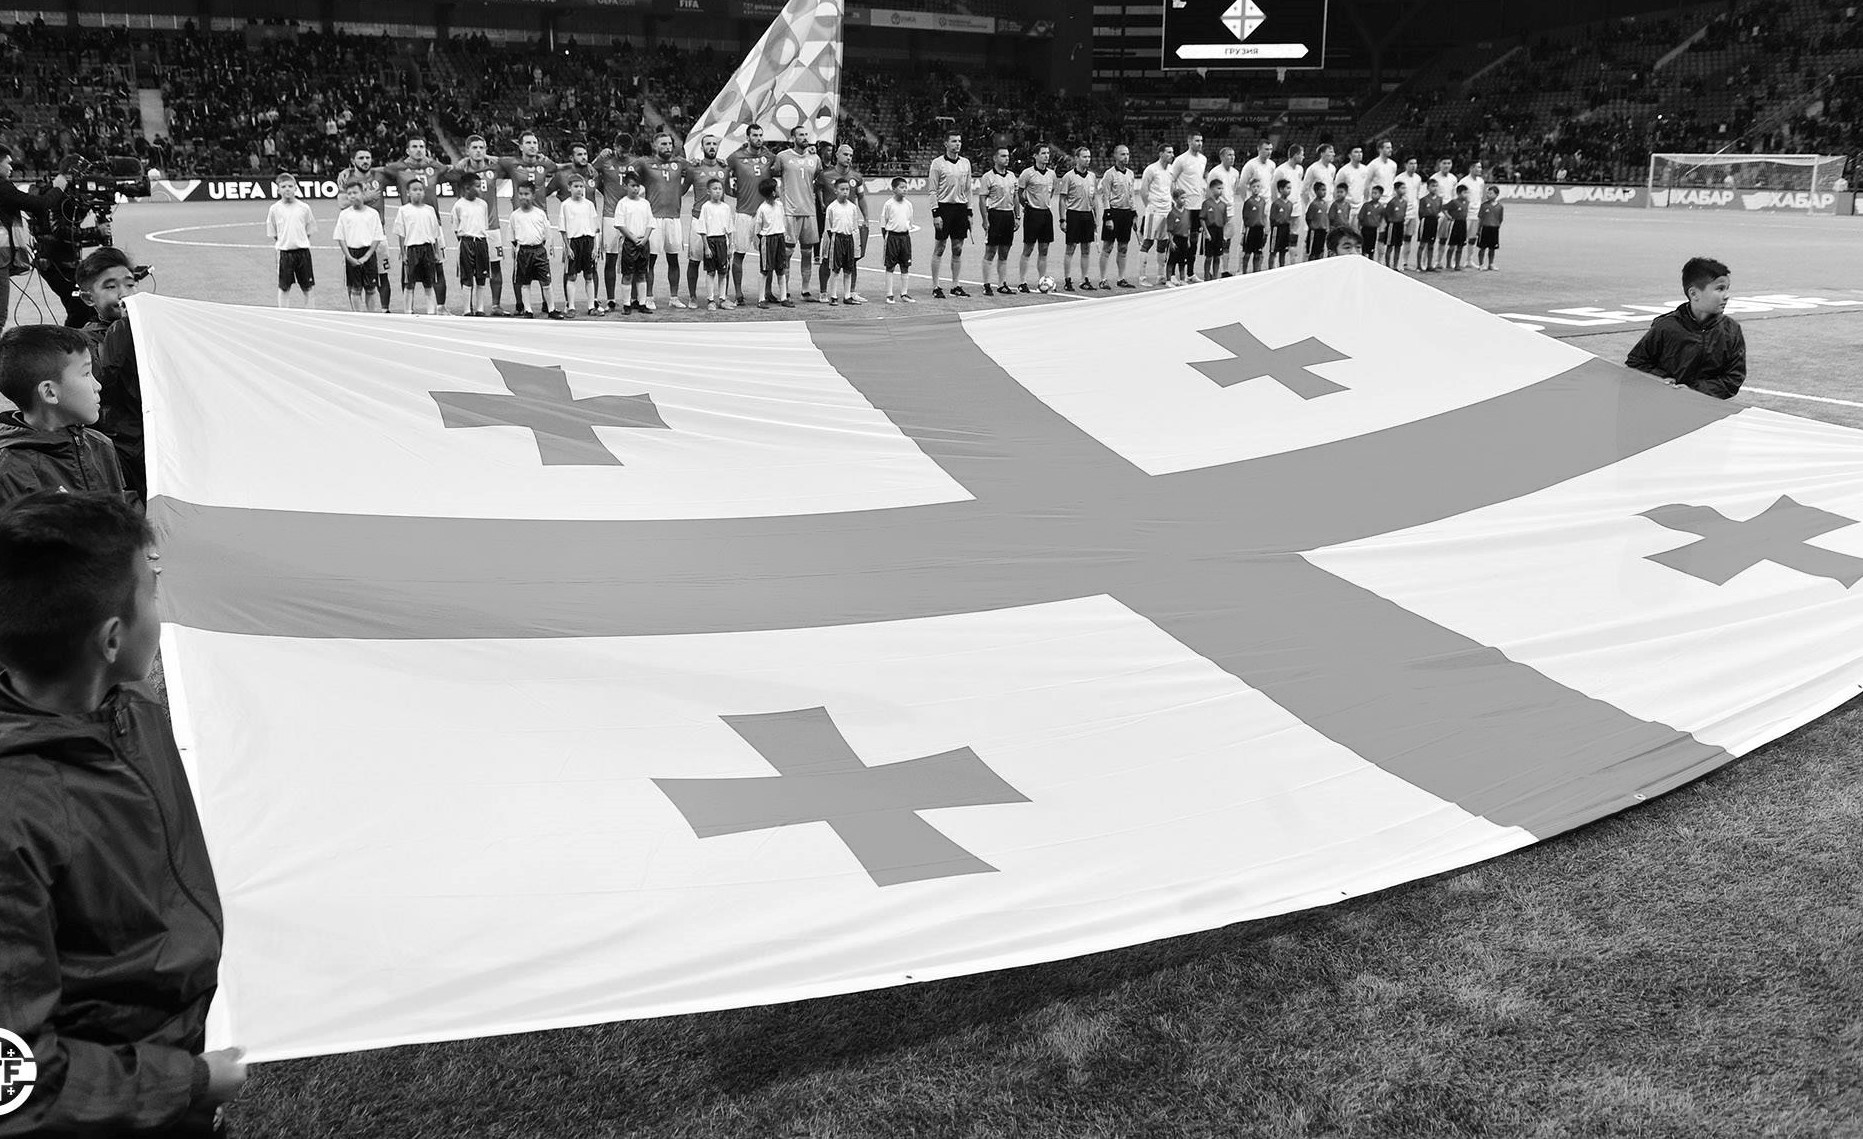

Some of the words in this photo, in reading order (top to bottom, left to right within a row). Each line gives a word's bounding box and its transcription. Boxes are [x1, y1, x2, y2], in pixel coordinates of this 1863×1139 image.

[662, 170, 670, 181] 4
[754, 165, 761, 176] 5
[208, 181, 266, 200] UEFA
[1584, 186, 1636, 203] ХАБАР
[1676, 190, 1735, 206] ХАБАР
